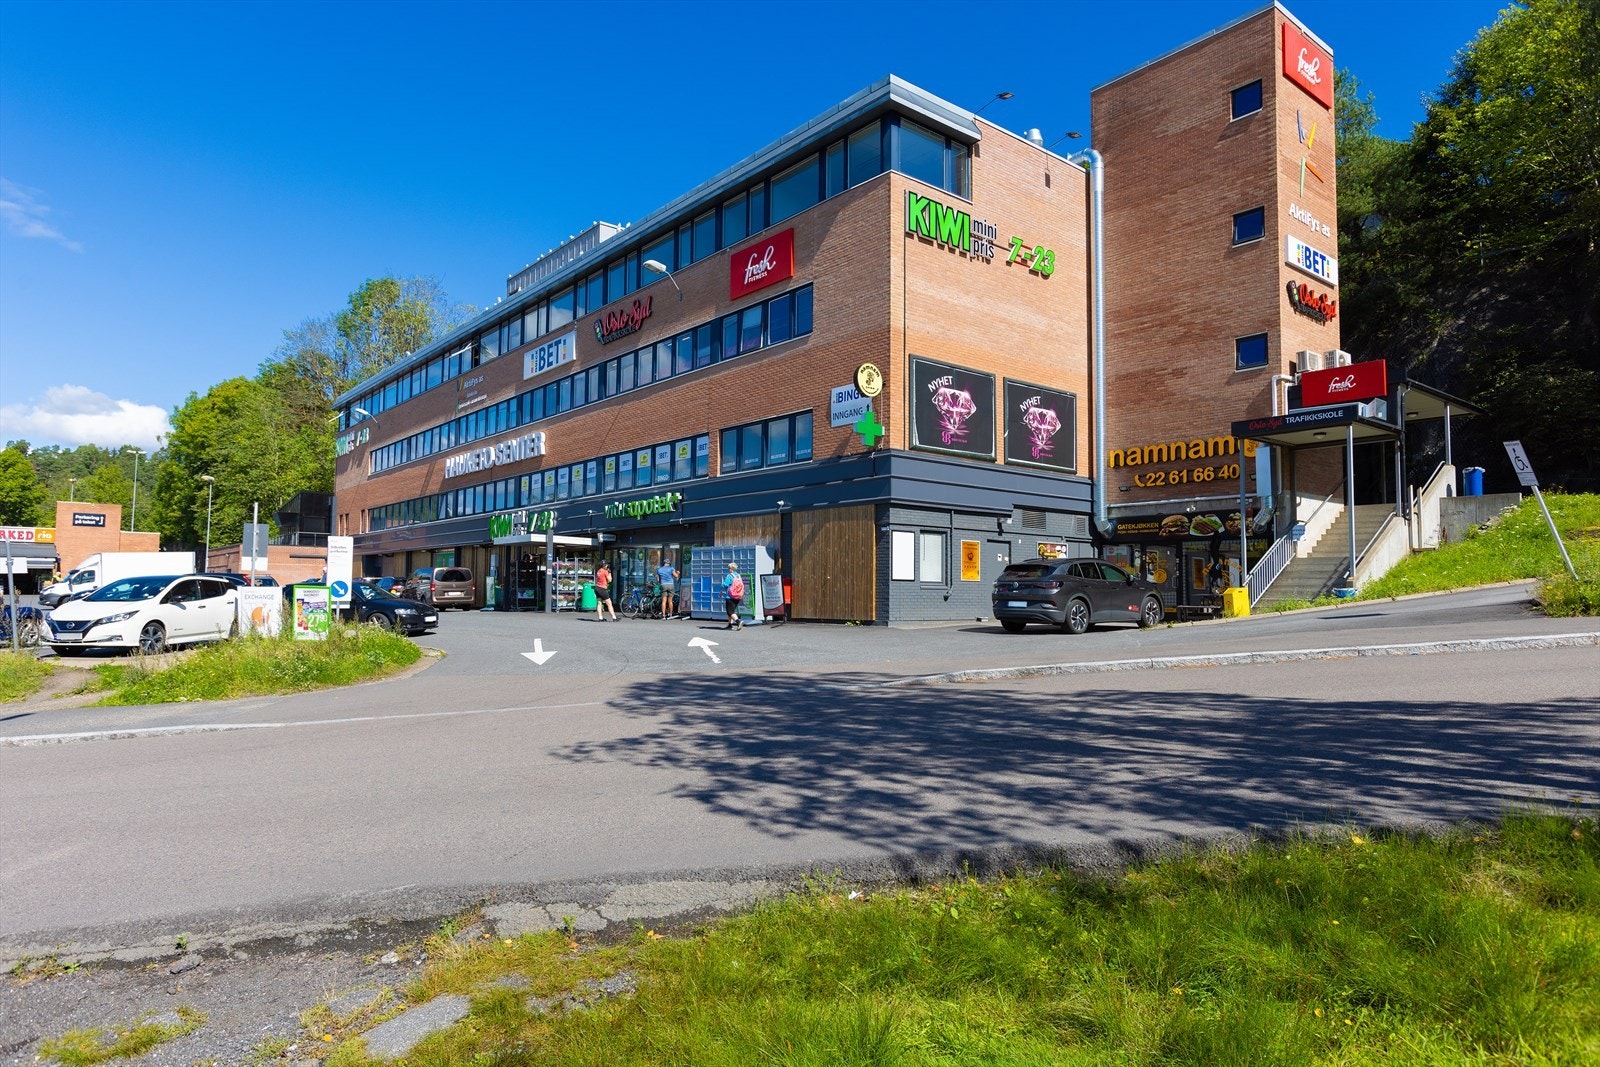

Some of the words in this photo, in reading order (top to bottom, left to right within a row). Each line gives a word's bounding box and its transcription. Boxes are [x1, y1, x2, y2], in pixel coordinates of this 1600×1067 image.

[1297, 47, 1322, 83] fresh
[908, 190, 971, 252] KIWI
[973, 219, 997, 240] mini
[1289, 203, 1320, 232] AktiFys
[1321, 224, 1331, 238] as
[973, 239, 995, 258] pris
[1305, 245, 1327, 277] BET
[744, 245, 776, 285] fresh
[748, 271, 768, 283] FITNESS
[1299, 283, 1320, 309] Oslo
[603, 309, 629, 336] Oslo
[629, 295, 652, 330] Syd
[538, 339, 562, 372] BET
[928, 375, 953, 392] NYHET
[1328, 374, 1357, 393] fresh
[832, 407, 863, 421] INNGANG
[1019, 396, 1041, 412] NYHET
[1249, 420, 1267, 430] Oslo
[1285, 410, 1344, 424] TRAFIKKSKOLE
[445, 446, 495, 479] HAUKETO
[495, 432, 546, 466] SENTER
[1109, 435, 1235, 468] namnam
[1145, 471, 1166, 487] 22
[1169, 469, 1187, 484] 61
[1193, 466, 1215, 482] 66
[1218, 463, 1240, 479] 40
[37, 531, 52, 539] rio
[490, 513, 514, 541] KIWI
